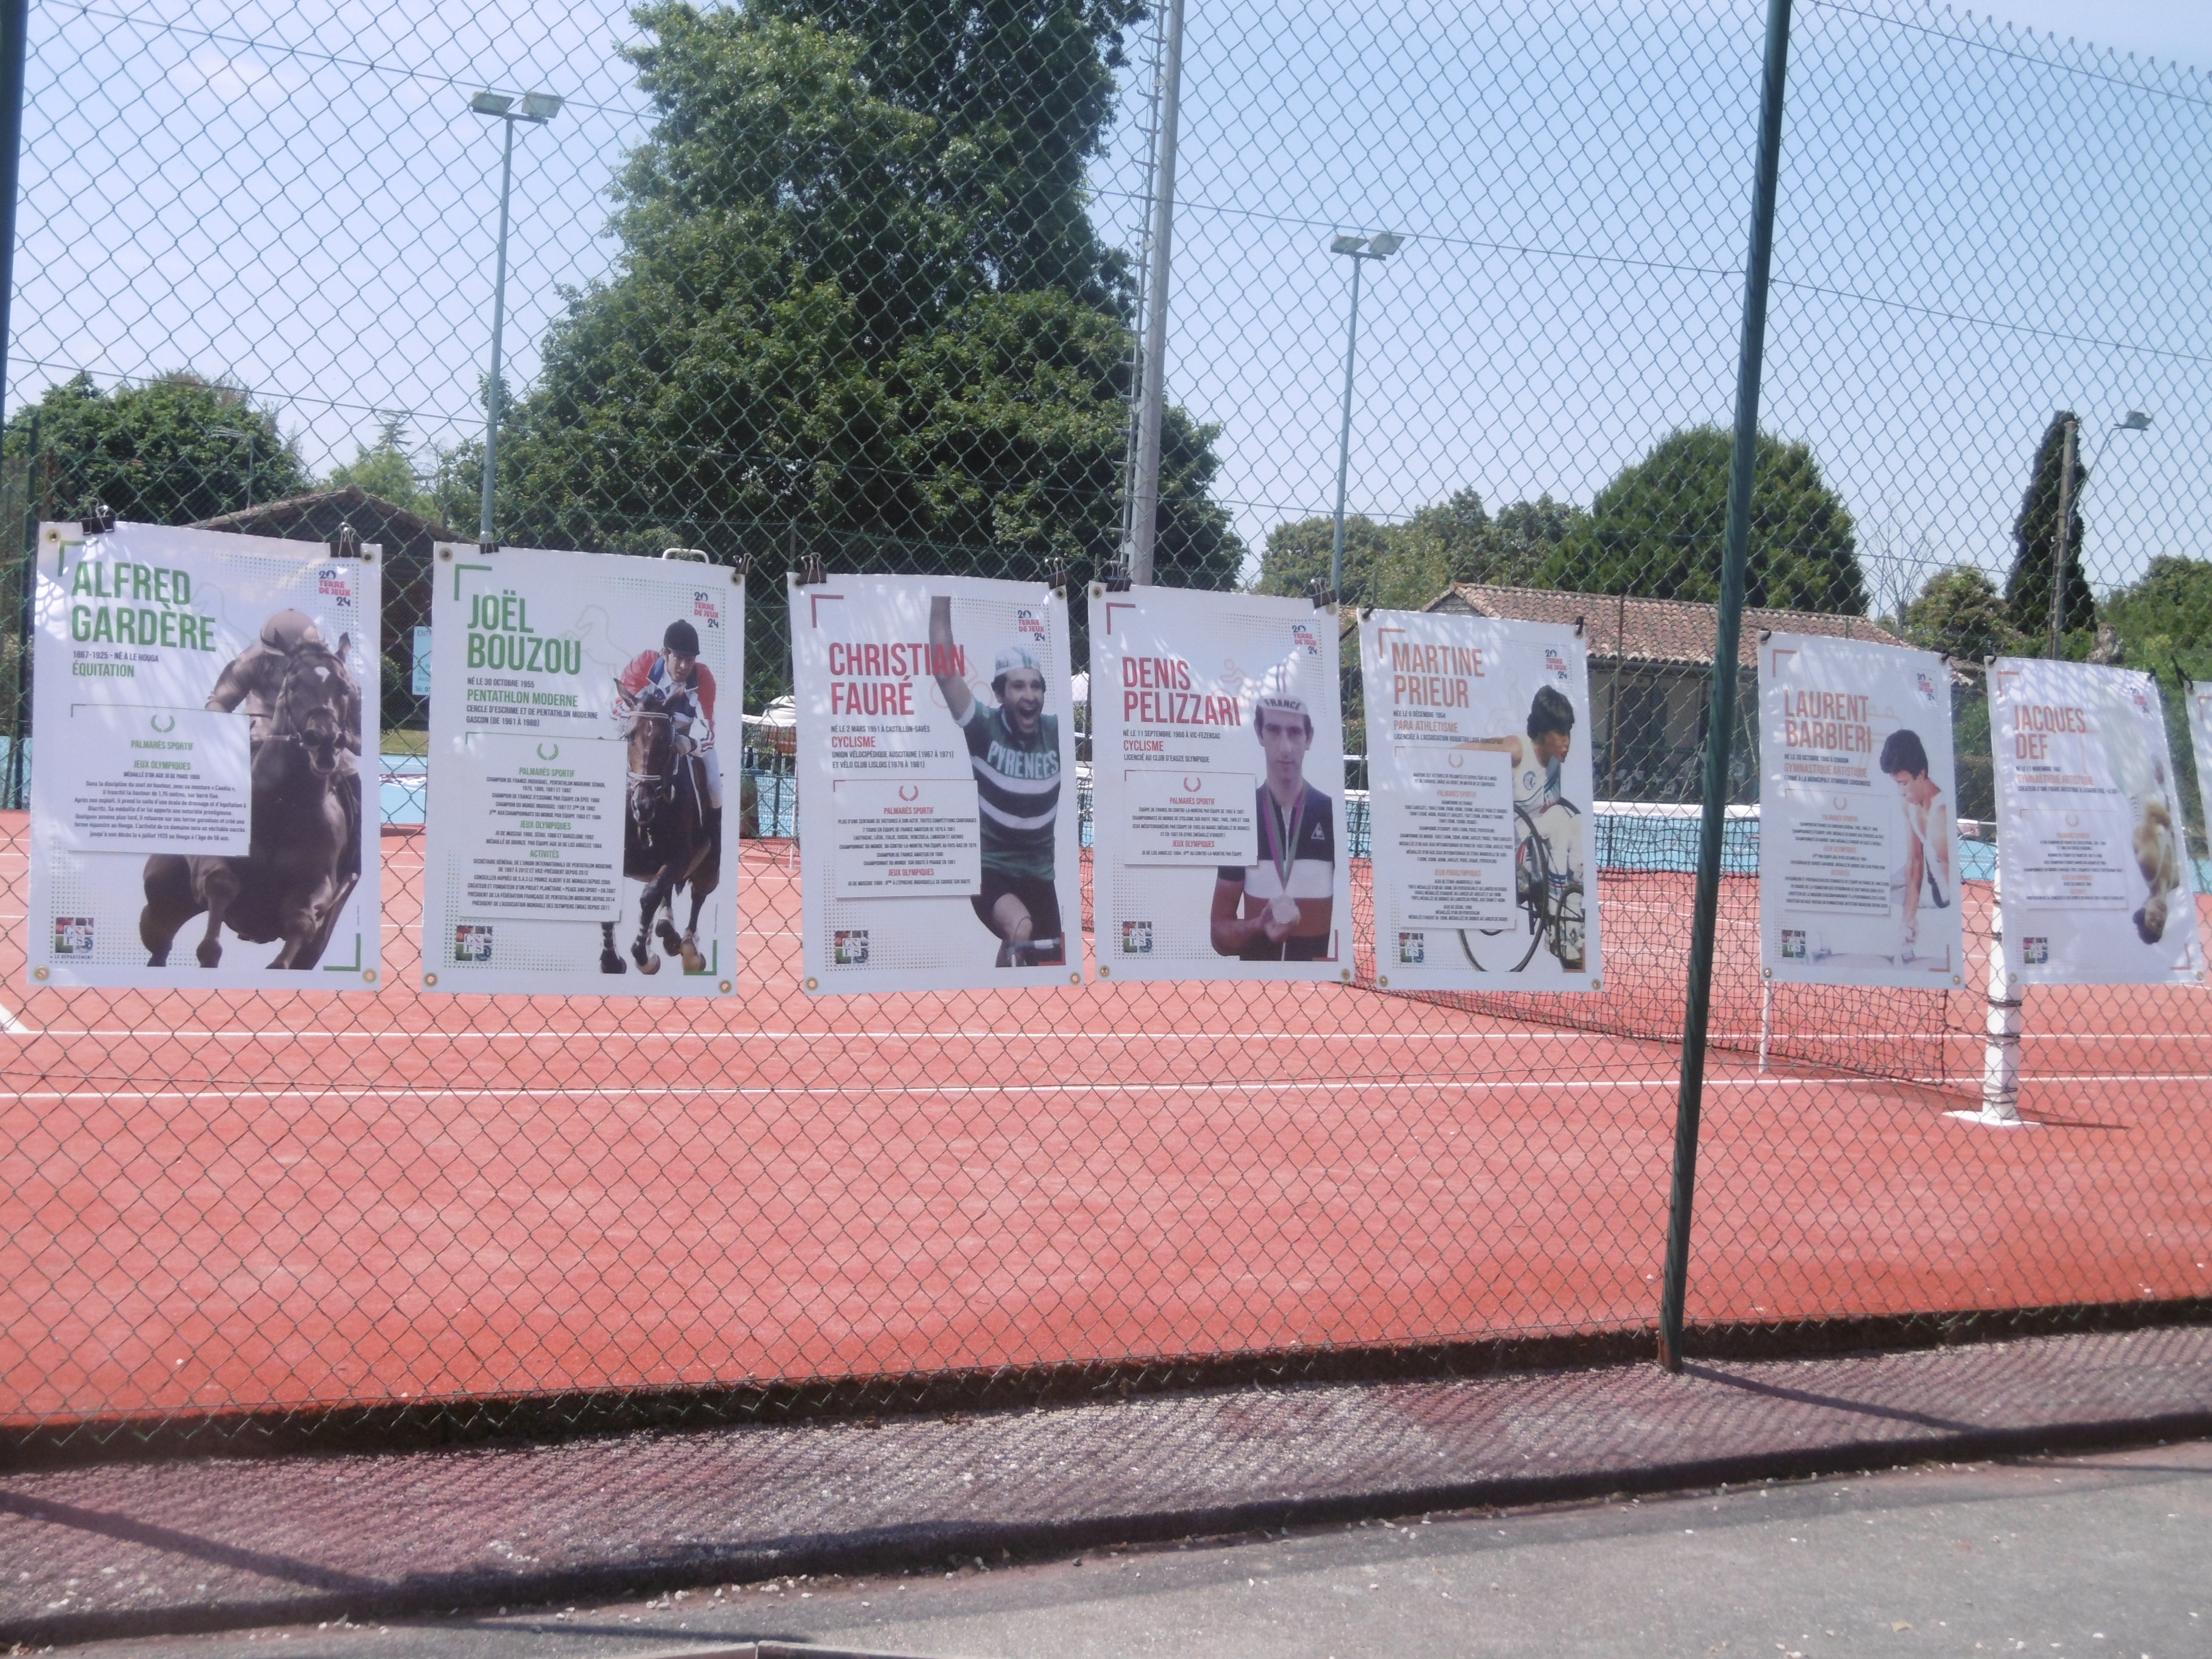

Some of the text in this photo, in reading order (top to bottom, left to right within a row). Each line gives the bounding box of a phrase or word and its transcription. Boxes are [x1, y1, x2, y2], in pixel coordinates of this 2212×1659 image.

[319, 570, 336, 579] 20
[72, 561, 190, 605] ALFRED
[319, 580, 345, 588] TERRE
[331, 588, 350, 596] JEUX
[337, 596, 350, 607] 24
[694, 601, 714, 611] TERRE
[467, 589, 534, 634] JOËL
[703, 610, 719, 619] JEUX
[72, 601, 216, 652] GARDÈRE
[708, 618, 719, 629] 24
[1034, 632, 1045, 641] 24
[73, 650, 108, 659] 1867-1925
[114, 651, 122, 660] NÉ
[124, 651, 128, 660] À
[138, 654, 159, 662] HOUGA
[467, 632, 581, 675] BOUZOU
[1308, 646, 1317, 655] 24
[829, 642, 965, 677] CHRISTIAN
[1392, 642, 1485, 677] MARTINE
[72, 660, 134, 677] ÉQUITATION
[1122, 656, 1190, 690] DENIS
[1558, 671, 1567, 679] 24
[467, 676, 475, 685] NÉ
[493, 679, 518, 687] OCTOBRE
[831, 674, 914, 716] FAURÉ
[1394, 674, 1469, 708] PRIEUR
[467, 689, 578, 707] PENTATHLON MODERNE
[1265, 698, 1302, 710] FRANCE
[466, 704, 488, 713] CERCLE
[489, 706, 519, 714] D'ESCRIME
[537, 709, 571, 718] PENTATHLON
[572, 711, 598, 719] MODERNE
[1124, 690, 1241, 726] PELIZZARI
[1784, 689, 1869, 723] LAURENT
[466, 715, 489, 724] GASCON
[490, 716, 500, 724] (DE
[517, 717, 521, 725] À
[2014, 705, 2087, 733] JACQUES
[831, 724, 838, 733] NÉ
[881, 724, 885, 732] À
[886, 724, 930, 733] CASTILLON-SAVÈS
[1394, 720, 1458, 733] PARA ATHLÉTISME
[831, 736, 876, 748] CYCLISME
[1785, 720, 1872, 753] BARBIERI
[131, 740, 193, 750] PALMARÈS SPORTIF
[1123, 740, 1164, 751] CYCLISME
[2016, 733, 2048, 759] DEF
[849, 749, 888, 758] VÉLOCIPÉDIQUE
[935, 749, 938, 758] À
[939, 750, 954, 758] 1971)
[133, 760, 191, 770] JEUX OLYMPIQUES
[840, 759, 853, 768] VÉLO
[904, 759, 909, 768] À
[519, 767, 575, 777] PALMARÈS SPORTIF
[1784, 762, 1867, 778] GYMNASTIQUE ARTISTIQUE
[535, 821, 572, 830] OLYMPIQUES
[529, 849, 560, 858] ACTIVITÉS
